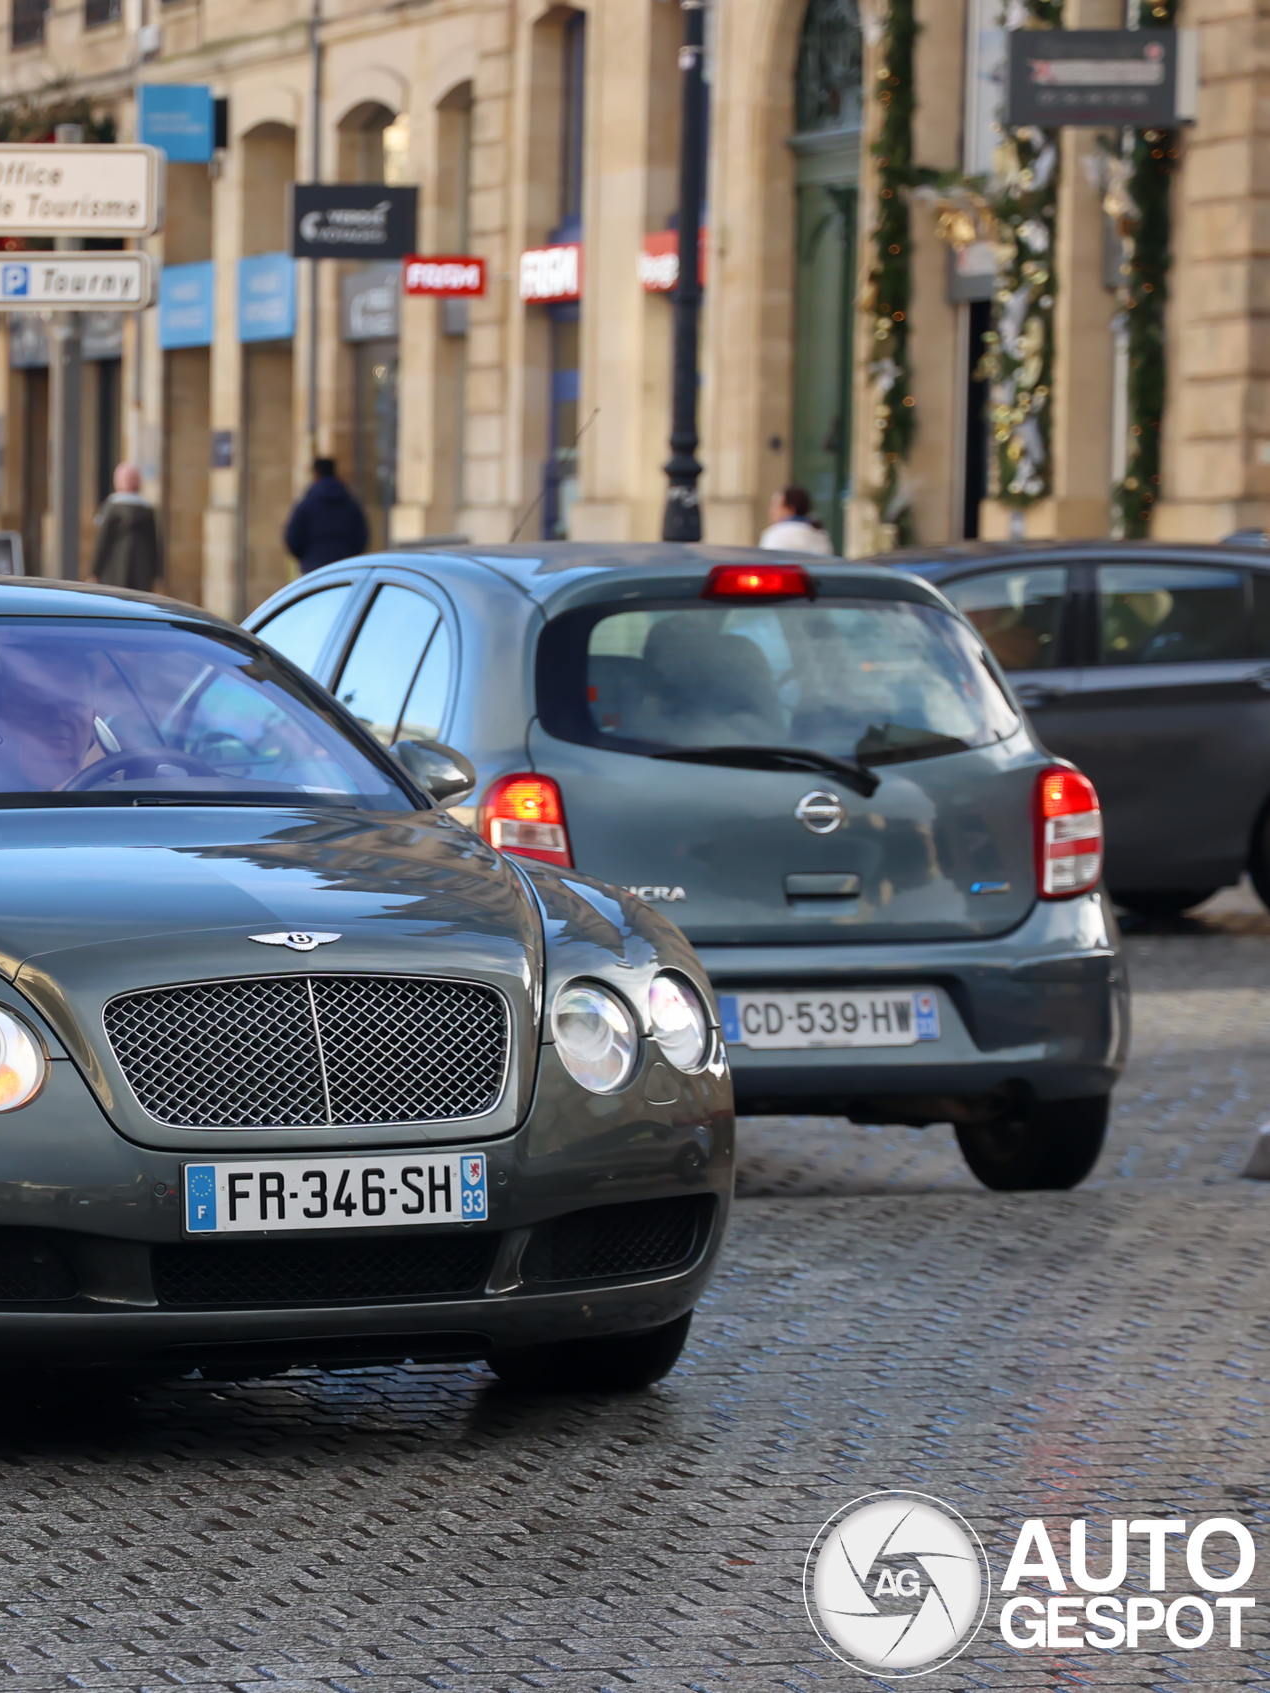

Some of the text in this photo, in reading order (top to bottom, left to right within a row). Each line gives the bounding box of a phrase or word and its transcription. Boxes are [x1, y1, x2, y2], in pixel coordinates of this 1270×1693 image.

[27, 193, 141, 218] Tourisme
[6, 268, 134, 296] P Tourny
[622, 886, 686, 902] ICRA
[743, 1001, 911, 1035] CD-539-HW
[228, 1165, 452, 1221] FR-346-SH
[463, 1190, 485, 1213] 33
[197, 1206, 207, 1220] F
